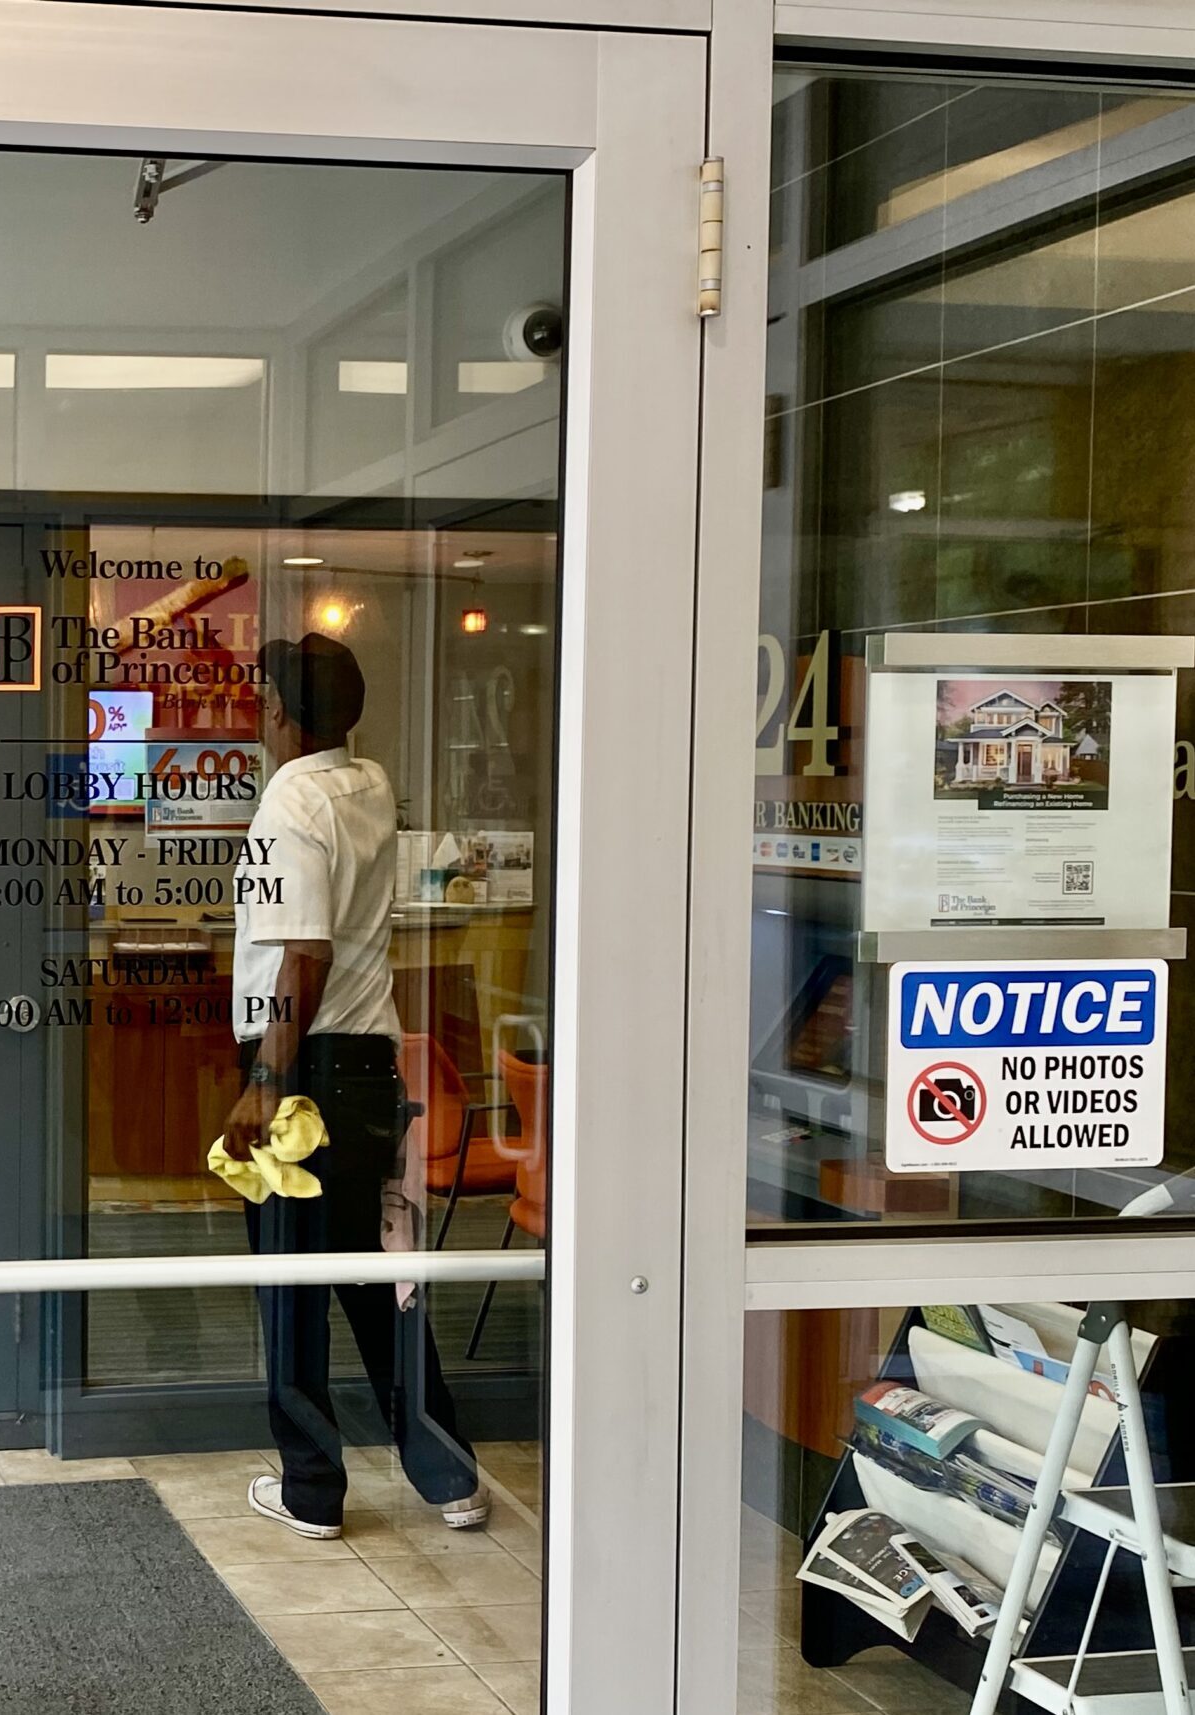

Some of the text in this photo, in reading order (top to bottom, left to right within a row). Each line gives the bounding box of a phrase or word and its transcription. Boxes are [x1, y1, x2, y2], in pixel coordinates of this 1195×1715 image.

[40, 550, 222, 580] Welcome to
[52, 617, 119, 649] The
[130, 617, 222, 649] Bank
[52, 652, 269, 684] of Princeton
[756, 629, 839, 777] 24
[4, 772, 124, 801] LOBBY
[134, 772, 256, 801] HOURS
[774, 801, 861, 832] BANKING
[157, 838, 276, 866] FRIDAY
[54, 878, 105, 905] AM
[117, 881, 143, 905] to
[155, 877, 223, 905] 5:00
[235, 877, 284, 905] PM
[41, 959, 216, 988] SATURDAY:
[43, 998, 93, 1027] AM
[107, 1001, 132, 1026] to
[148, 997, 232, 1026] 12:00
[243, 996, 294, 1025] PM
[910, 980, 1150, 1036] NOTICE
[1002, 1055, 1144, 1081] NO PHOTOS
[1005, 1089, 1138, 1115] OR VIDEOS
[1010, 1123, 1129, 1149] ALLOWED
